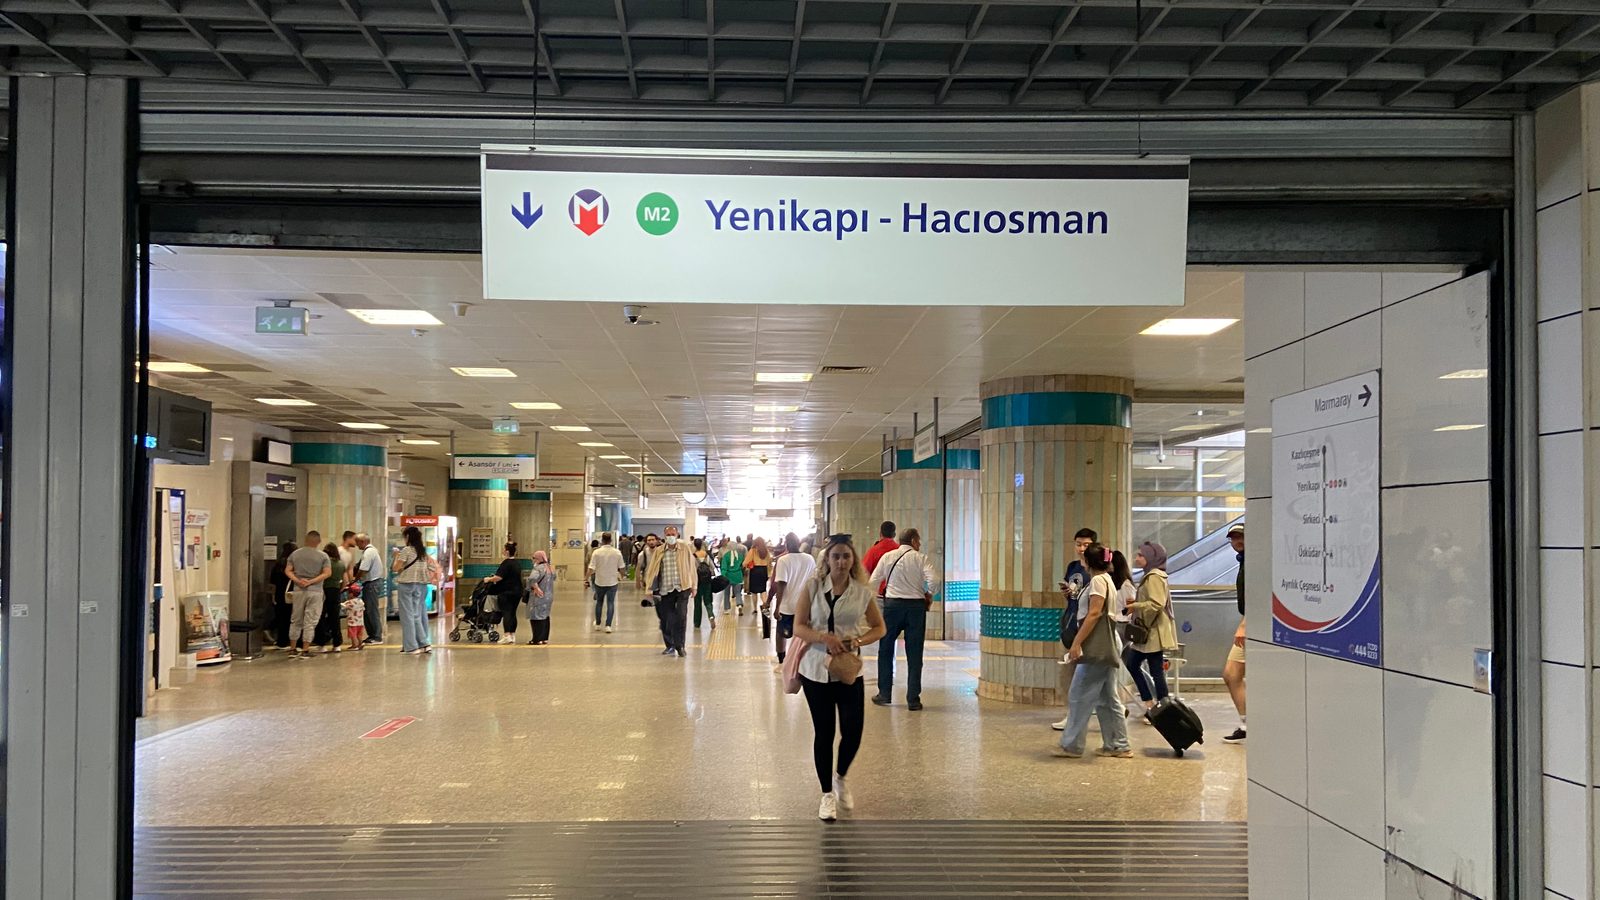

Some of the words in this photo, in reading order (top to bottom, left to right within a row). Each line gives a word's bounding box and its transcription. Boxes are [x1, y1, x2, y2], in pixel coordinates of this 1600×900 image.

[644, 207, 670, 221] M2
[704, 198, 869, 241] Yenikapı
[902, 202, 1108, 235] Hacıosman
[1314, 393, 1352, 413] Marmaray
[1296, 480, 1320, 493] Yenikapı
[1302, 513, 1321, 525] Sirkeci
[1354, 644, 1367, 658] 444
